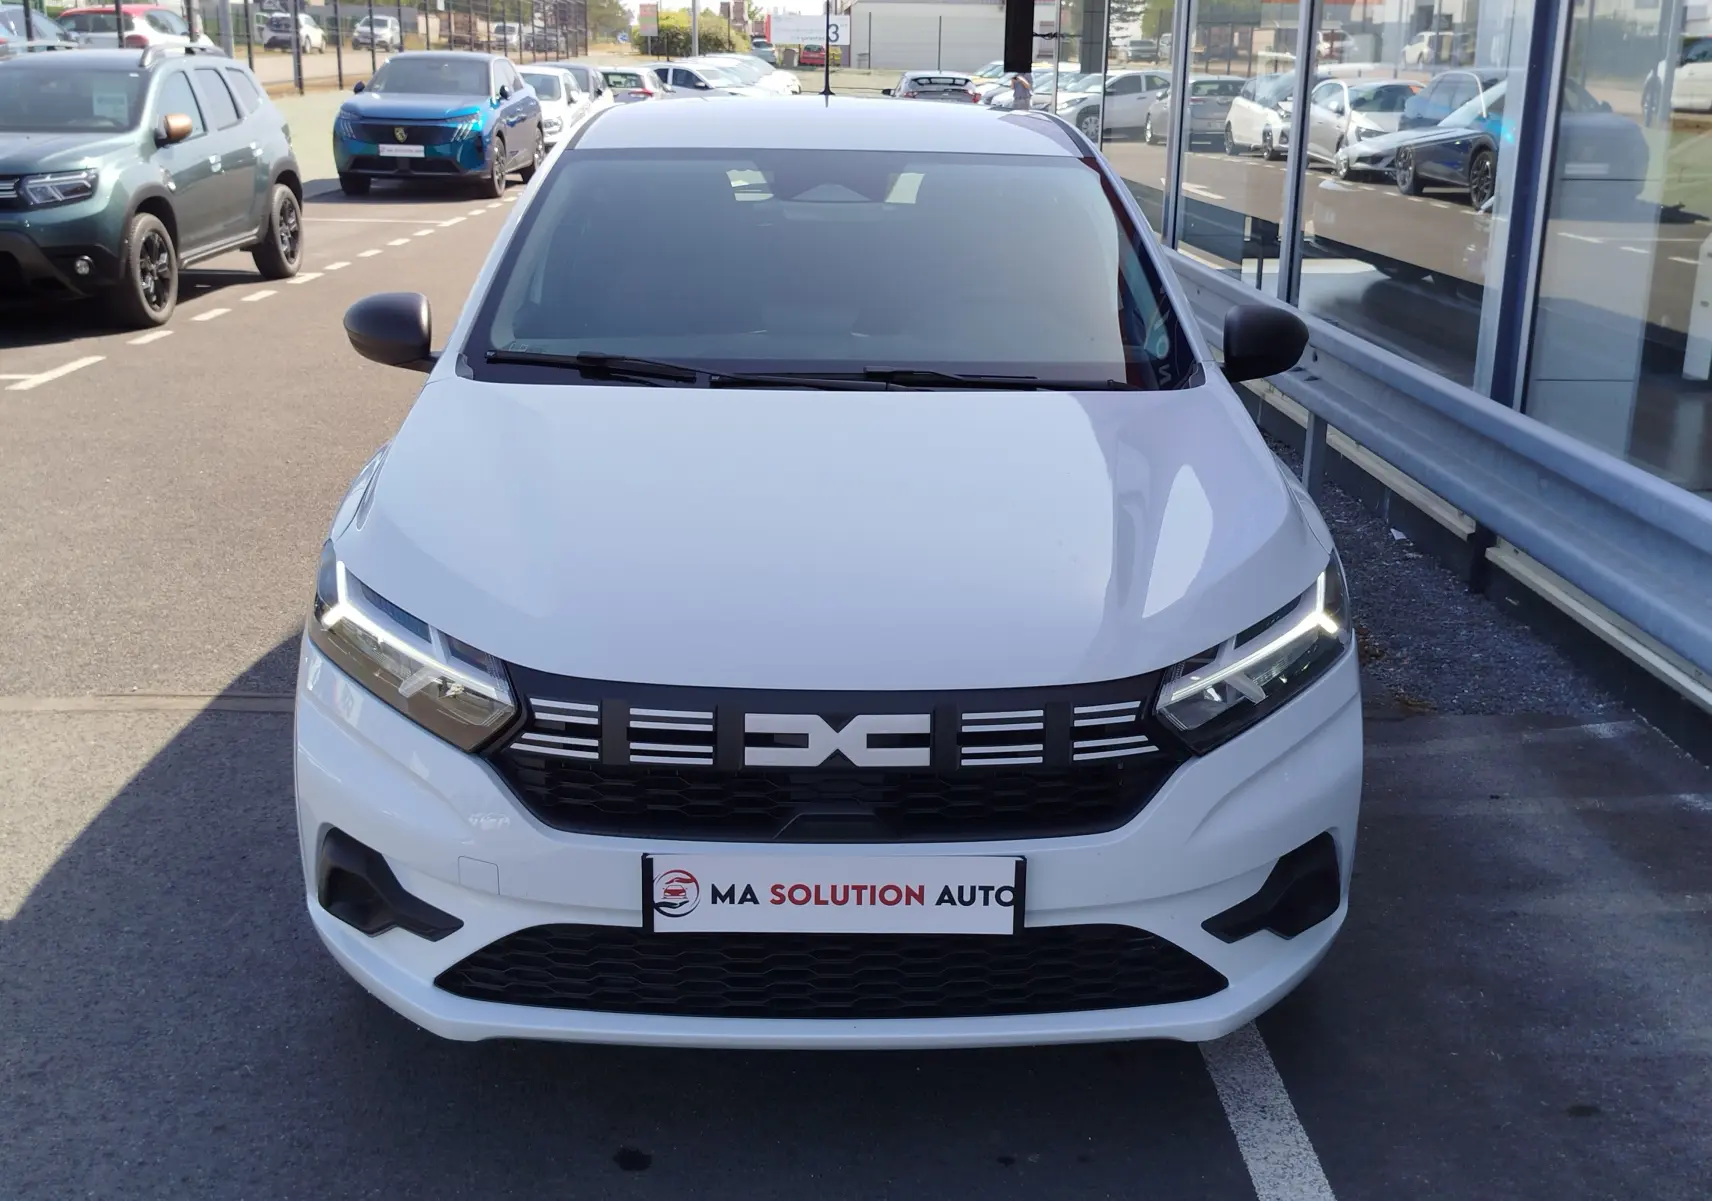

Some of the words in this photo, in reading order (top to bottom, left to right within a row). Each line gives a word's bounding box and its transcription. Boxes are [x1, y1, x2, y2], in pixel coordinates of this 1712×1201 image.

[711, 884, 760, 905] MA
[769, 884, 924, 906] SOLUTION
[935, 885, 1015, 907] AUTO
